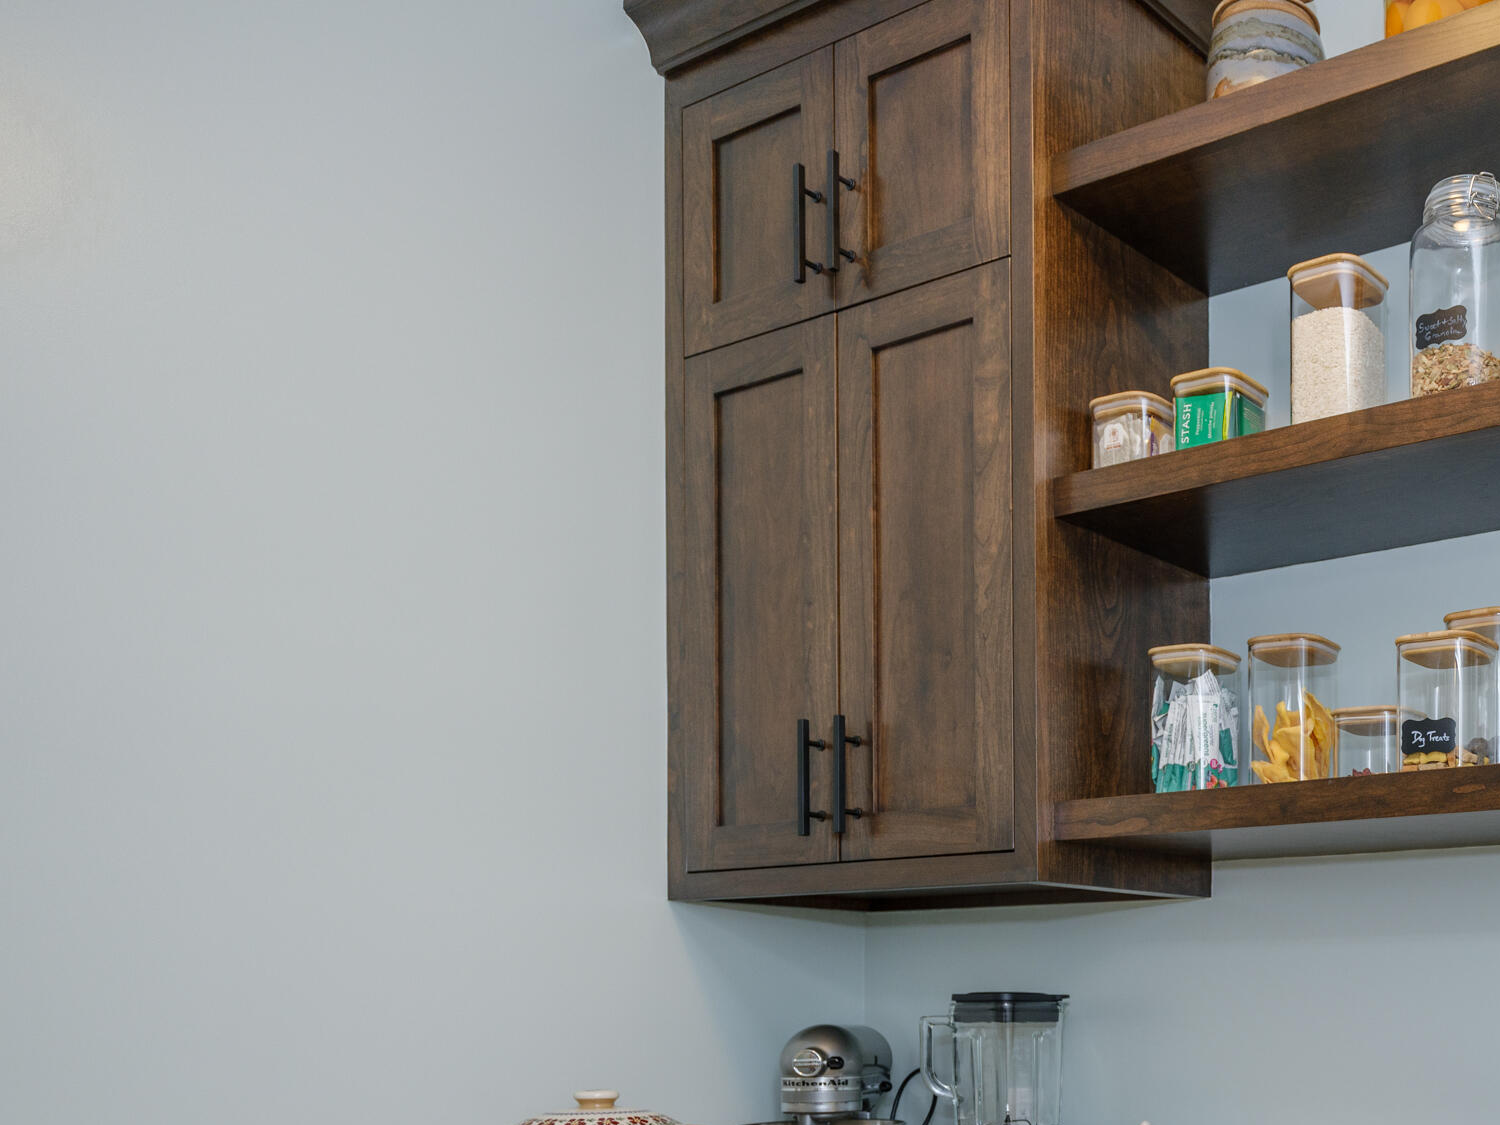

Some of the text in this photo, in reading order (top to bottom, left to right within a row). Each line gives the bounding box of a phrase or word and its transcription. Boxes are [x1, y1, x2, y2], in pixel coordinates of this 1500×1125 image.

[1181, 402, 1193, 444] STASH
[1411, 730, 1450, 748] Dog Treats
[782, 1079, 849, 1088] KitchenAid
